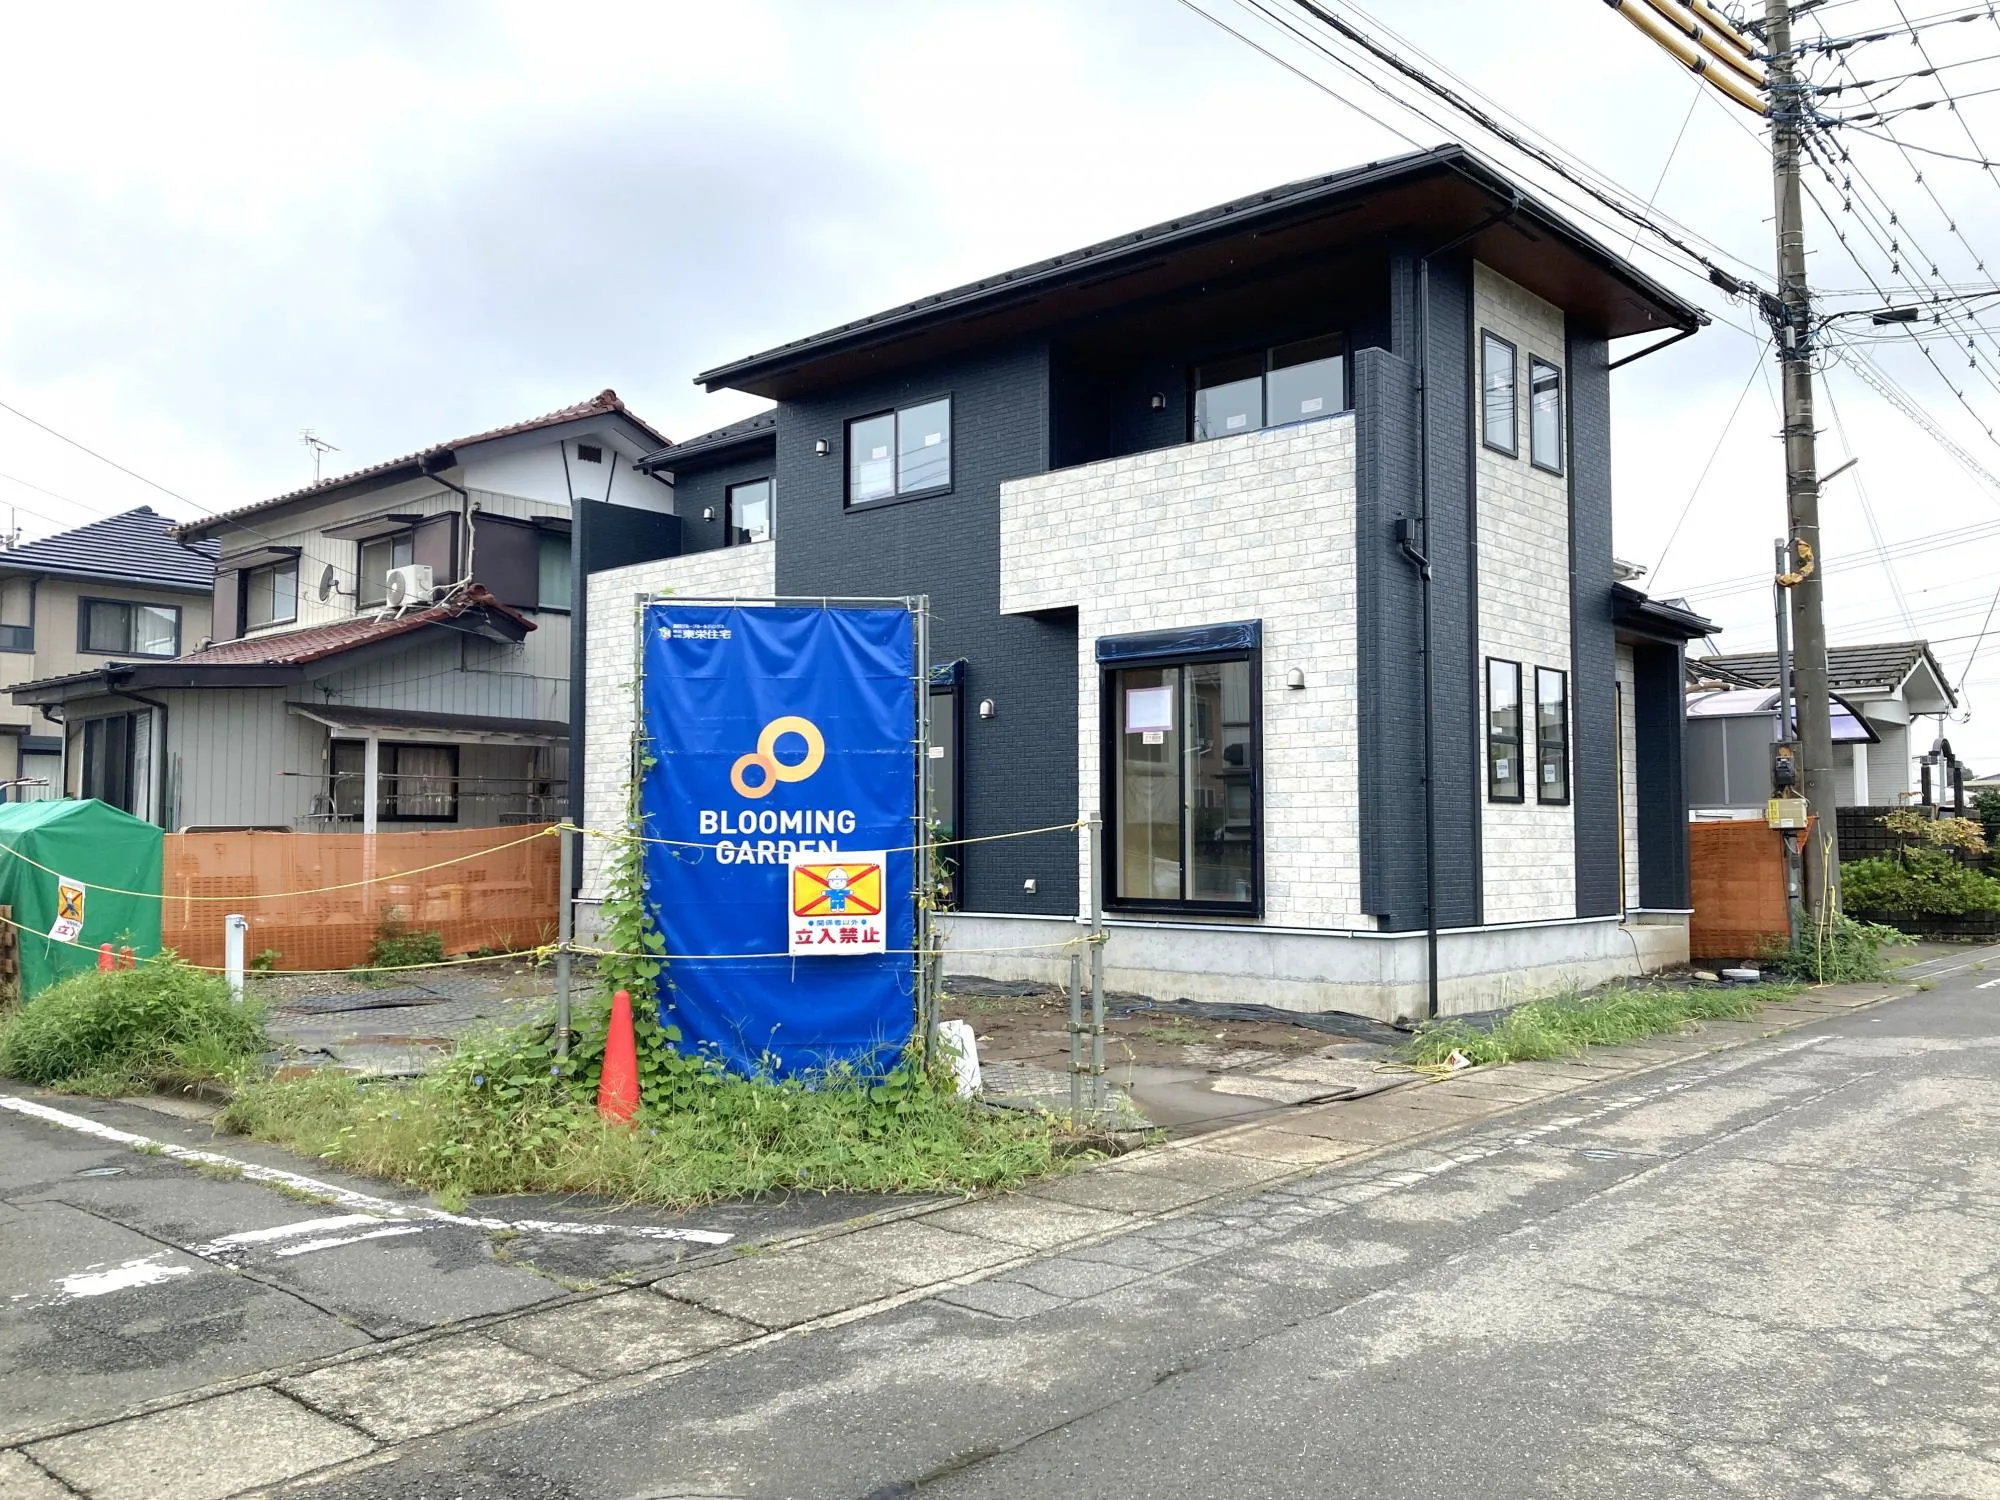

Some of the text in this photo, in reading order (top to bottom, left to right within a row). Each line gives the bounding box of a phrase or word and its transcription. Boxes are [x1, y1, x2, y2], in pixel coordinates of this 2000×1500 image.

[700, 810, 856, 834] BLOOMING
[795, 927, 880, 945] 立入禁止
